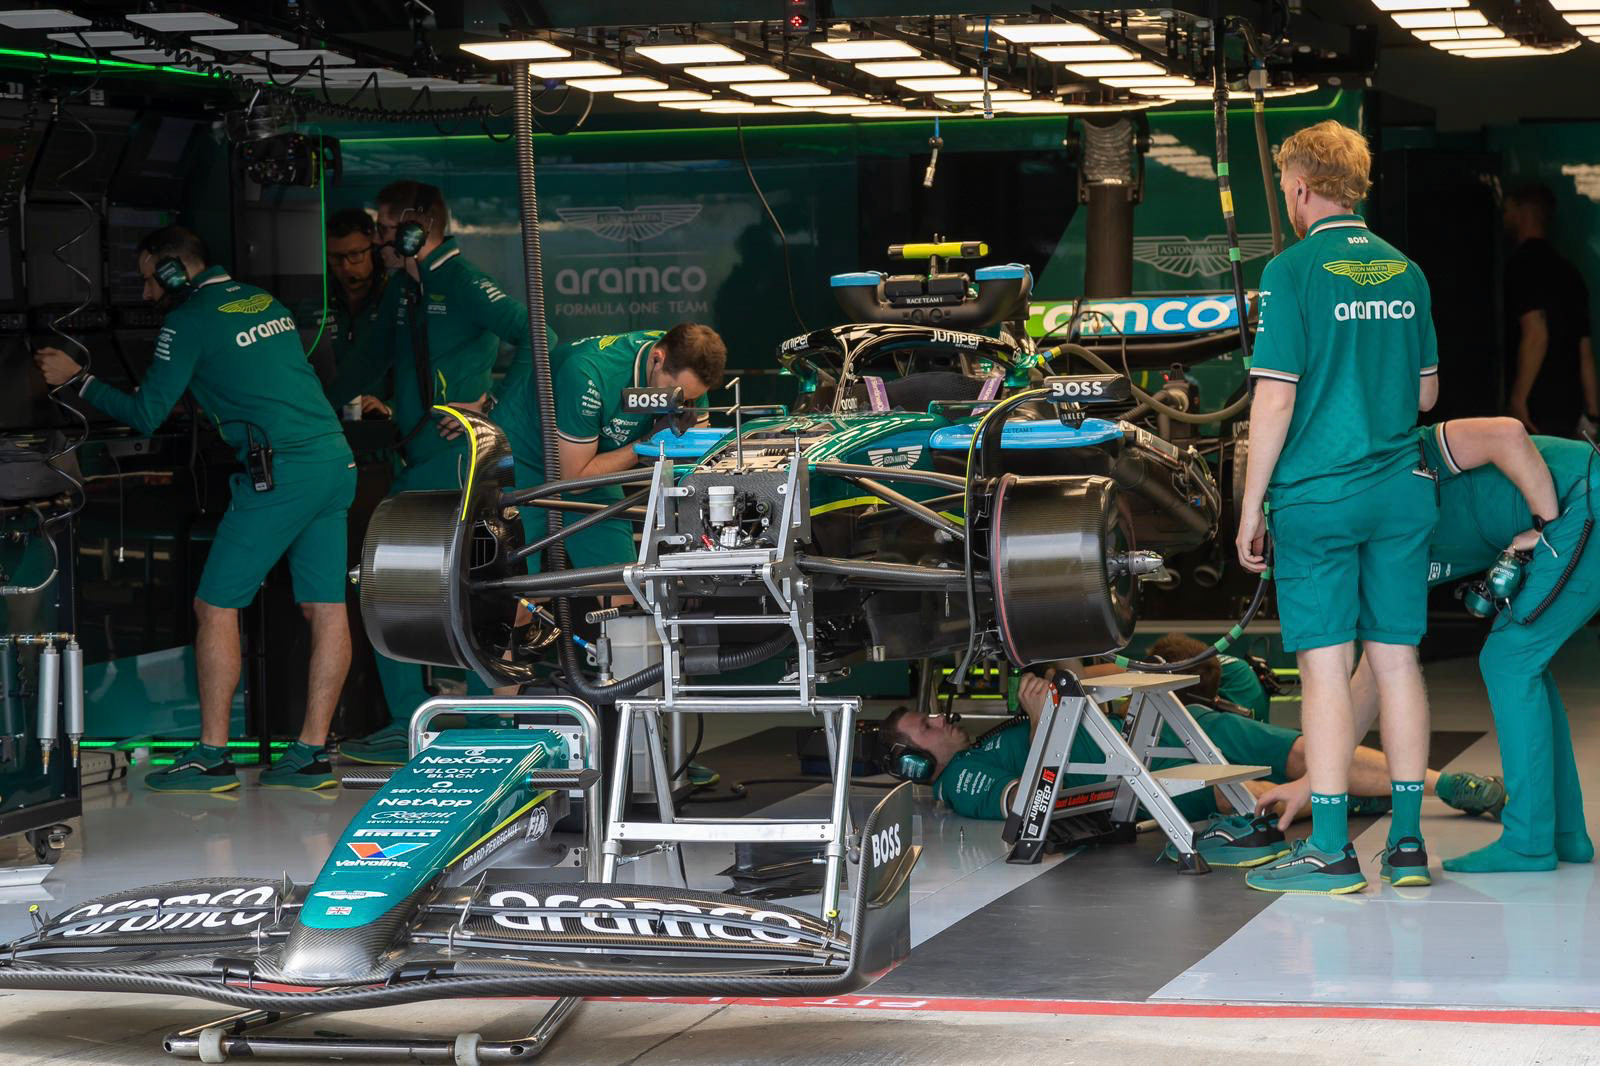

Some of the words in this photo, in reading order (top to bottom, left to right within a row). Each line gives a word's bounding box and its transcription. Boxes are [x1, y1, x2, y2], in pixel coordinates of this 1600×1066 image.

[1347, 236, 1369, 244] BOSS
[1160, 245, 1193, 254] ASTON
[1194, 245, 1230, 254] MARTI
[555, 265, 707, 295] aramco
[555, 302, 625, 316] FORMULA
[628, 301, 659, 314] ONE
[669, 300, 708, 313] TEAM
[1334, 300, 1416, 322] aramco
[235, 316, 296, 348] aramco
[1052, 381, 1104, 397] BOSS
[627, 392, 668, 408] BOSS
[419, 756, 513, 765] NexGen
[377, 798, 473, 807] NetApp
[1030, 789, 1044, 821] JUMBO
[1038, 785, 1052, 813] STEP
[1310, 795, 1341, 805] OSS
[352, 828, 442, 837] PIRELLI
[873, 822, 901, 868] BOSS
[335, 859, 409, 867] Valvoline
[59, 886, 275, 937] aramco
[489, 890, 801, 944] aramco
